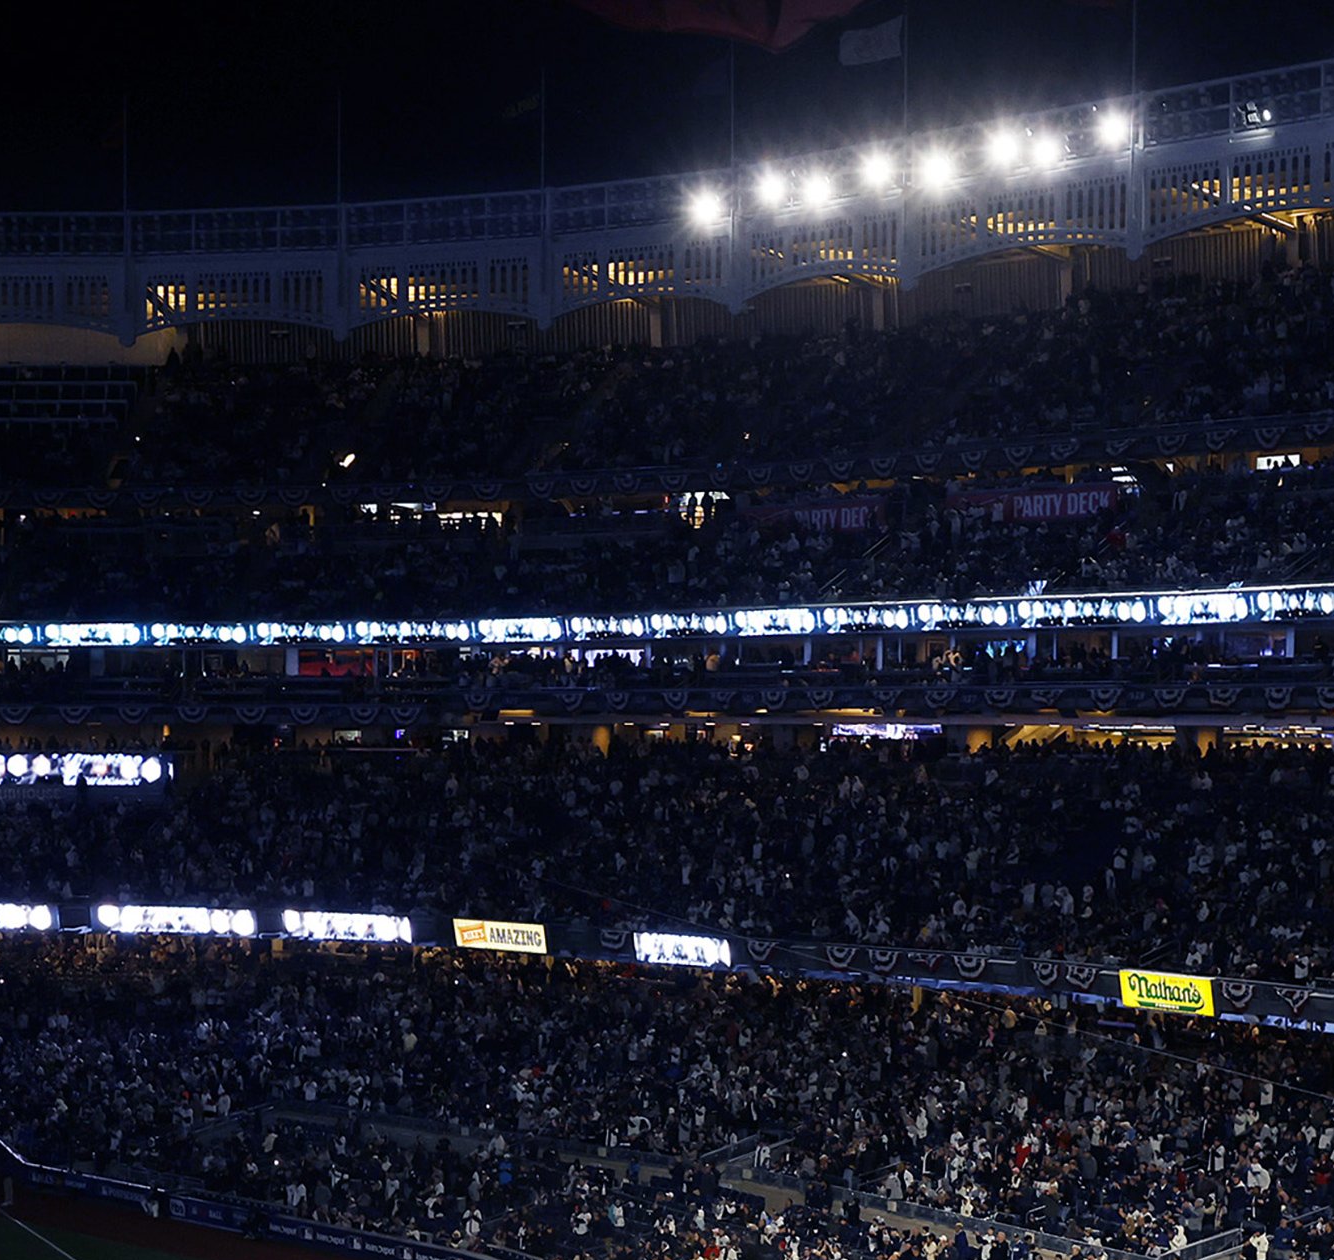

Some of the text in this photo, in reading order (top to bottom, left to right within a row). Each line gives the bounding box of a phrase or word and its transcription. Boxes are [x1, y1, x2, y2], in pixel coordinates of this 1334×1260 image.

[1012, 490, 1111, 518] PARTY DECK
[794, 508, 838, 530] PARTY
[489, 926, 542, 947] AMAZING
[1128, 973, 1201, 1004] Nathan's
